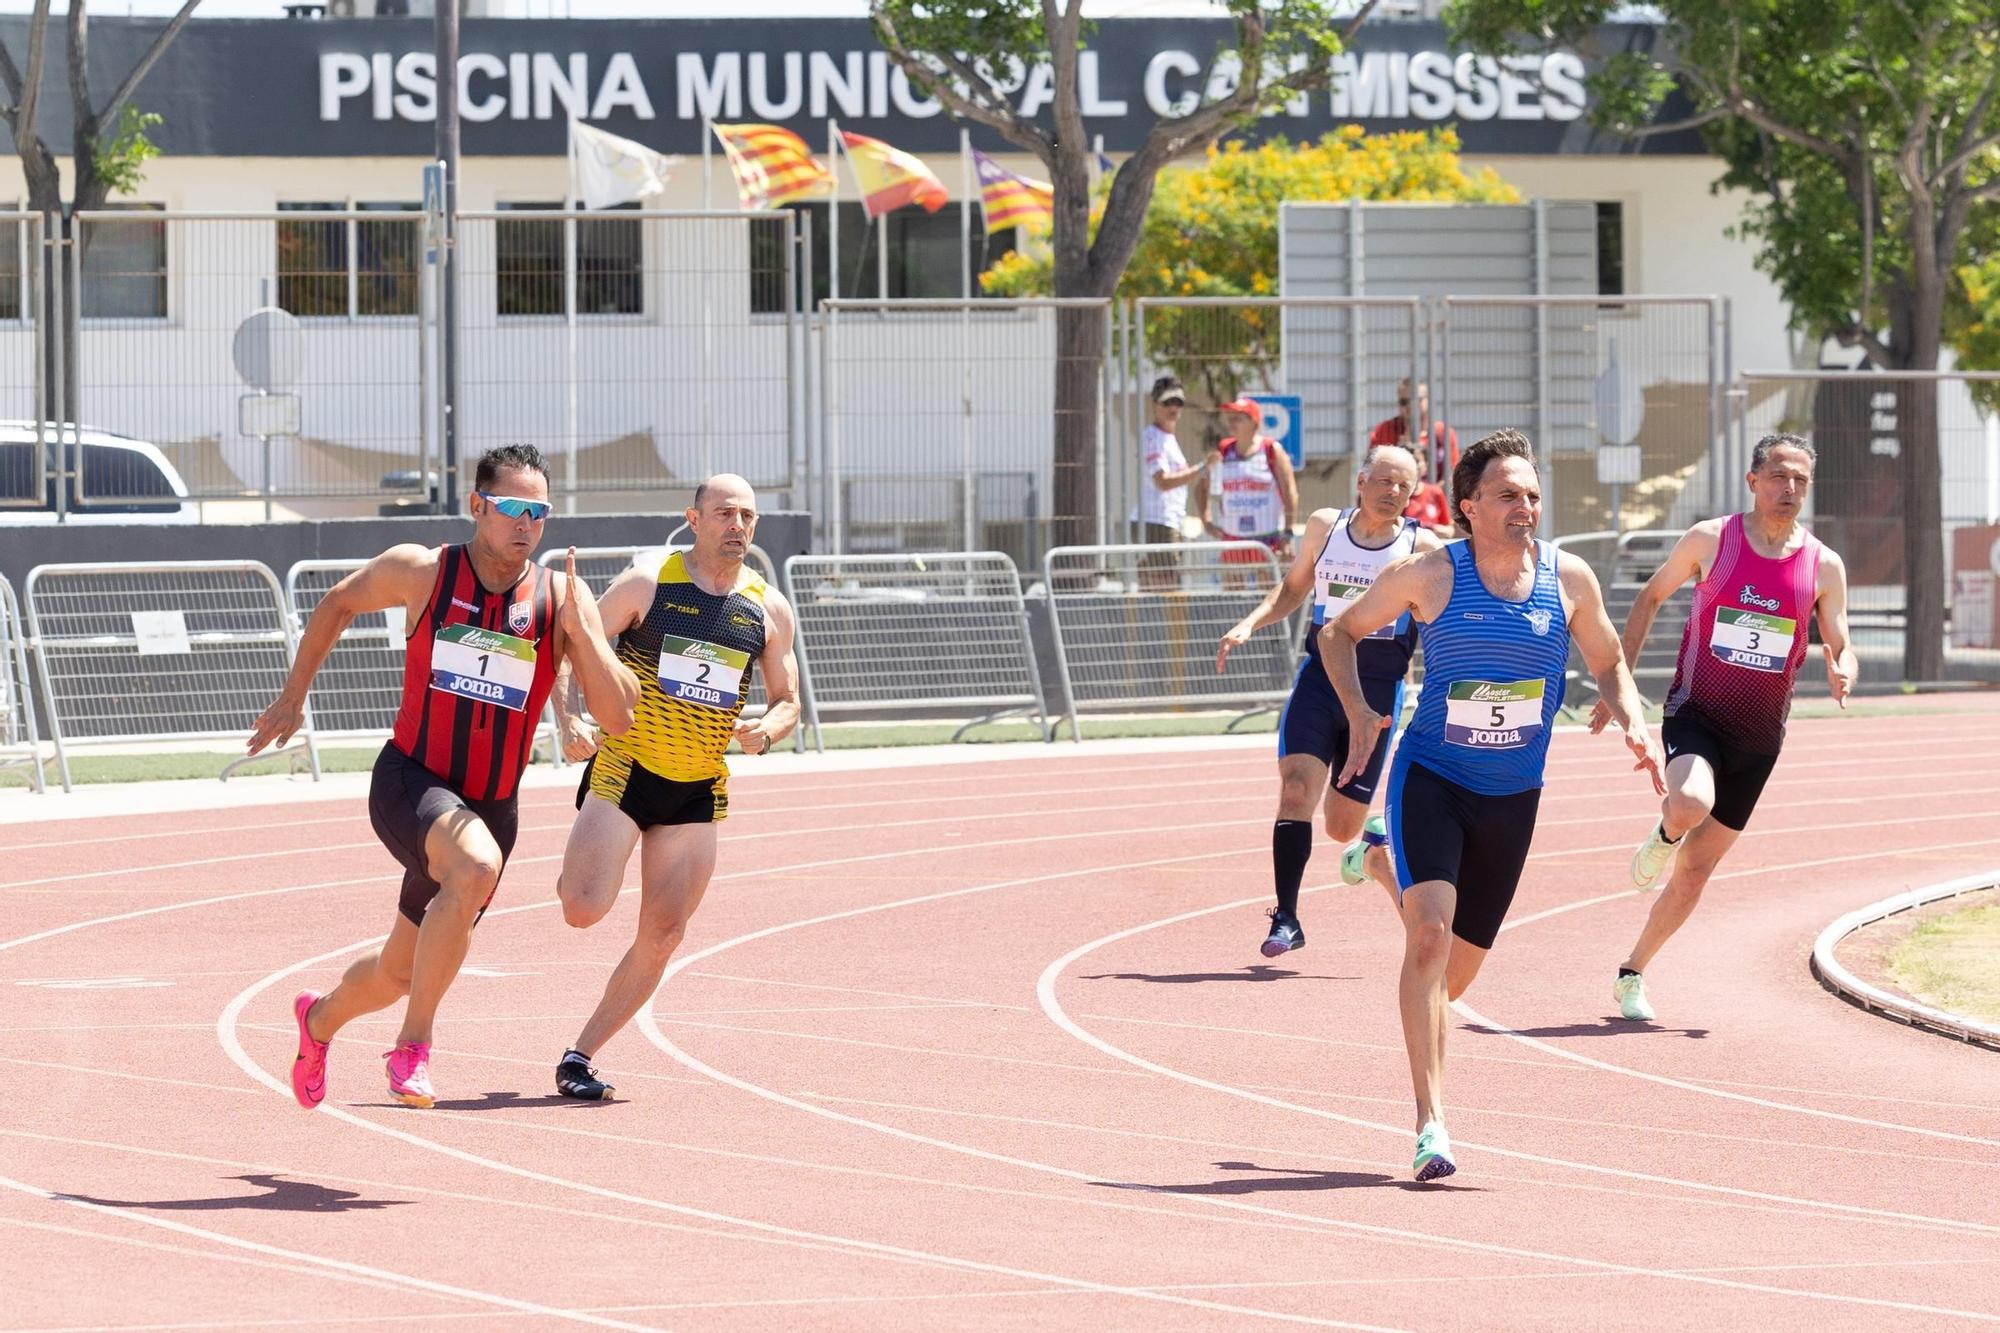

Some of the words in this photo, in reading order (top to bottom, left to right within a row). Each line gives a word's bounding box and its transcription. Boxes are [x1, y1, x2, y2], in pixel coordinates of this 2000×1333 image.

[319, 52, 655, 122] PISCINA
[1330, 50, 1587, 121] MISSES
[1747, 631, 1760, 650] 3
[478, 655, 489, 676] 1
[1728, 650, 1771, 667] Joma
[696, 664, 711, 684] 2
[450, 675, 504, 700] Joma
[676, 683, 720, 703] Joma
[1490, 706, 1505, 727] 5
[1467, 729, 1521, 745] Joma
